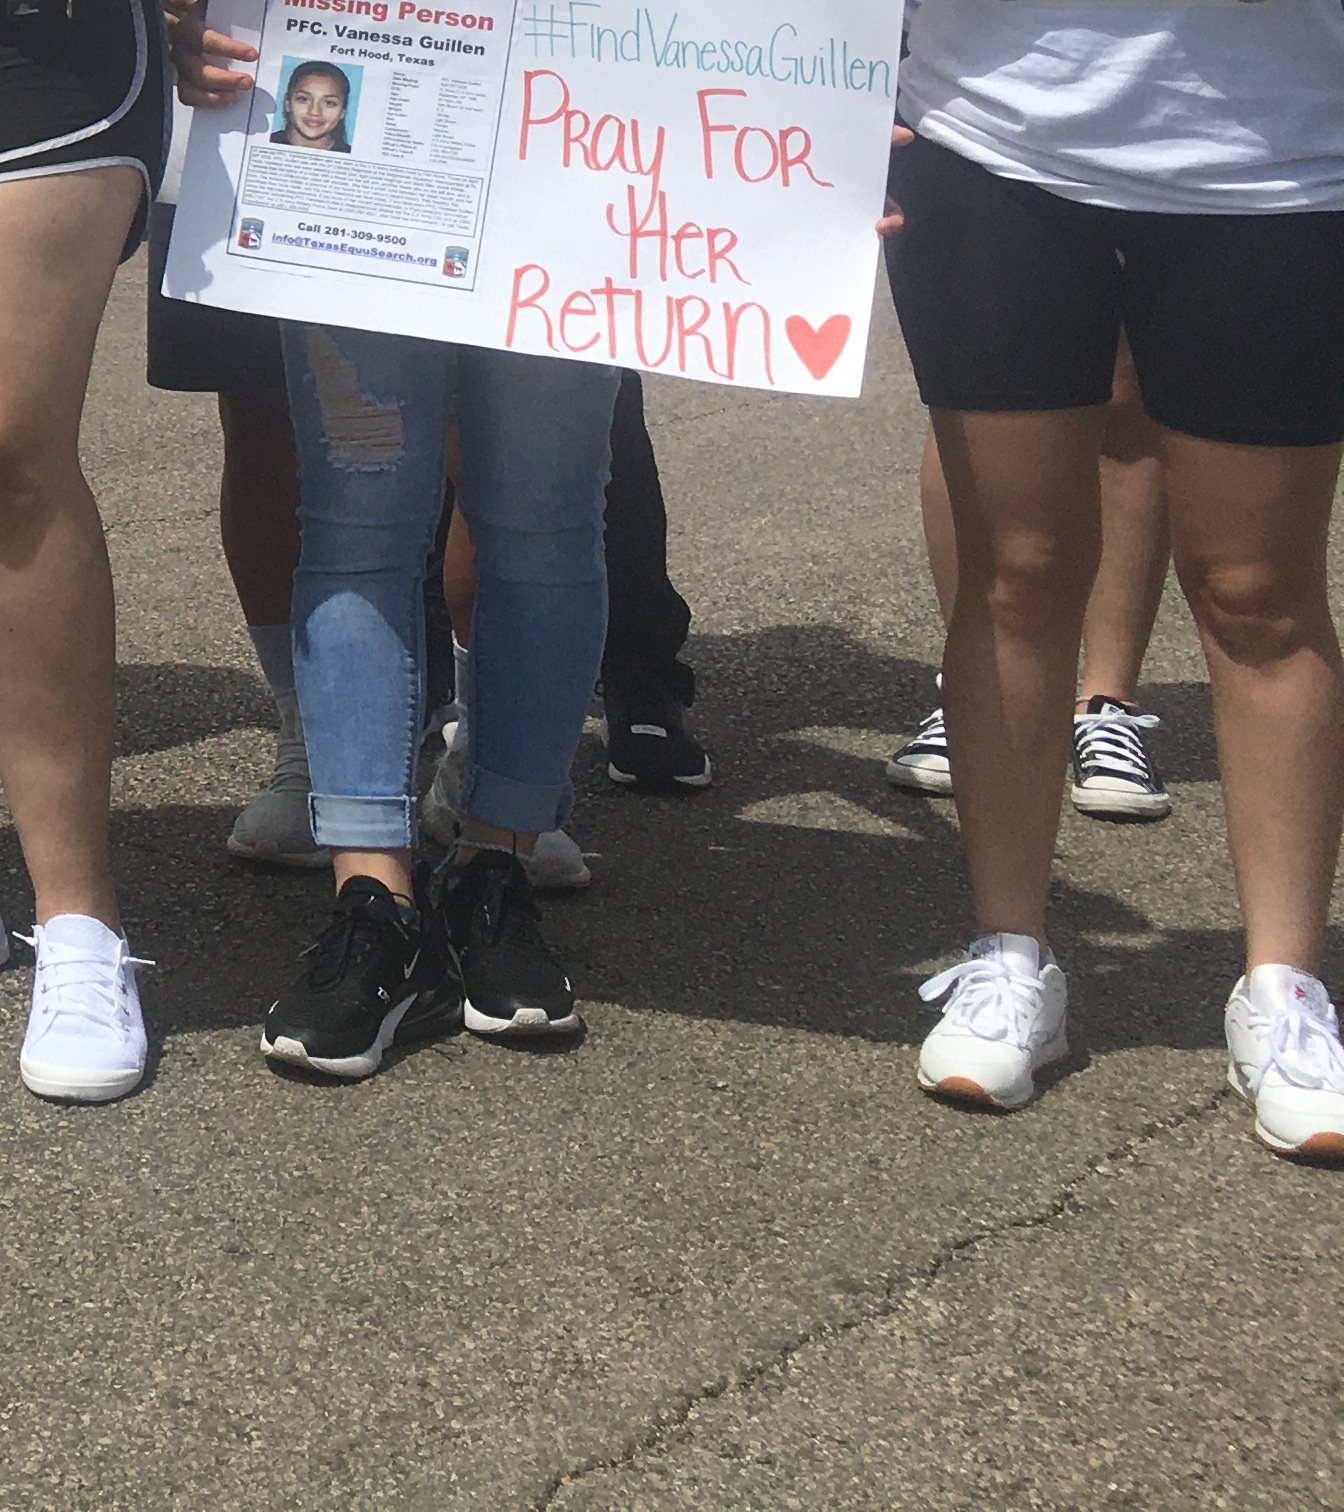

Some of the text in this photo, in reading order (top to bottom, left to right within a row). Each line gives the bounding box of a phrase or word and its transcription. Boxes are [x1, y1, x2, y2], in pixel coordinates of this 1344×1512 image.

[397, 1, 495, 32] Person
[285, 18, 486, 56] PFC. Vanessa Guillen
[522, 1, 891, 98] #FindVanessaGuillen
[330, 45, 435, 68] Fort Hood, Texas
[297, 220, 407, 247] Call 281-309-9500
